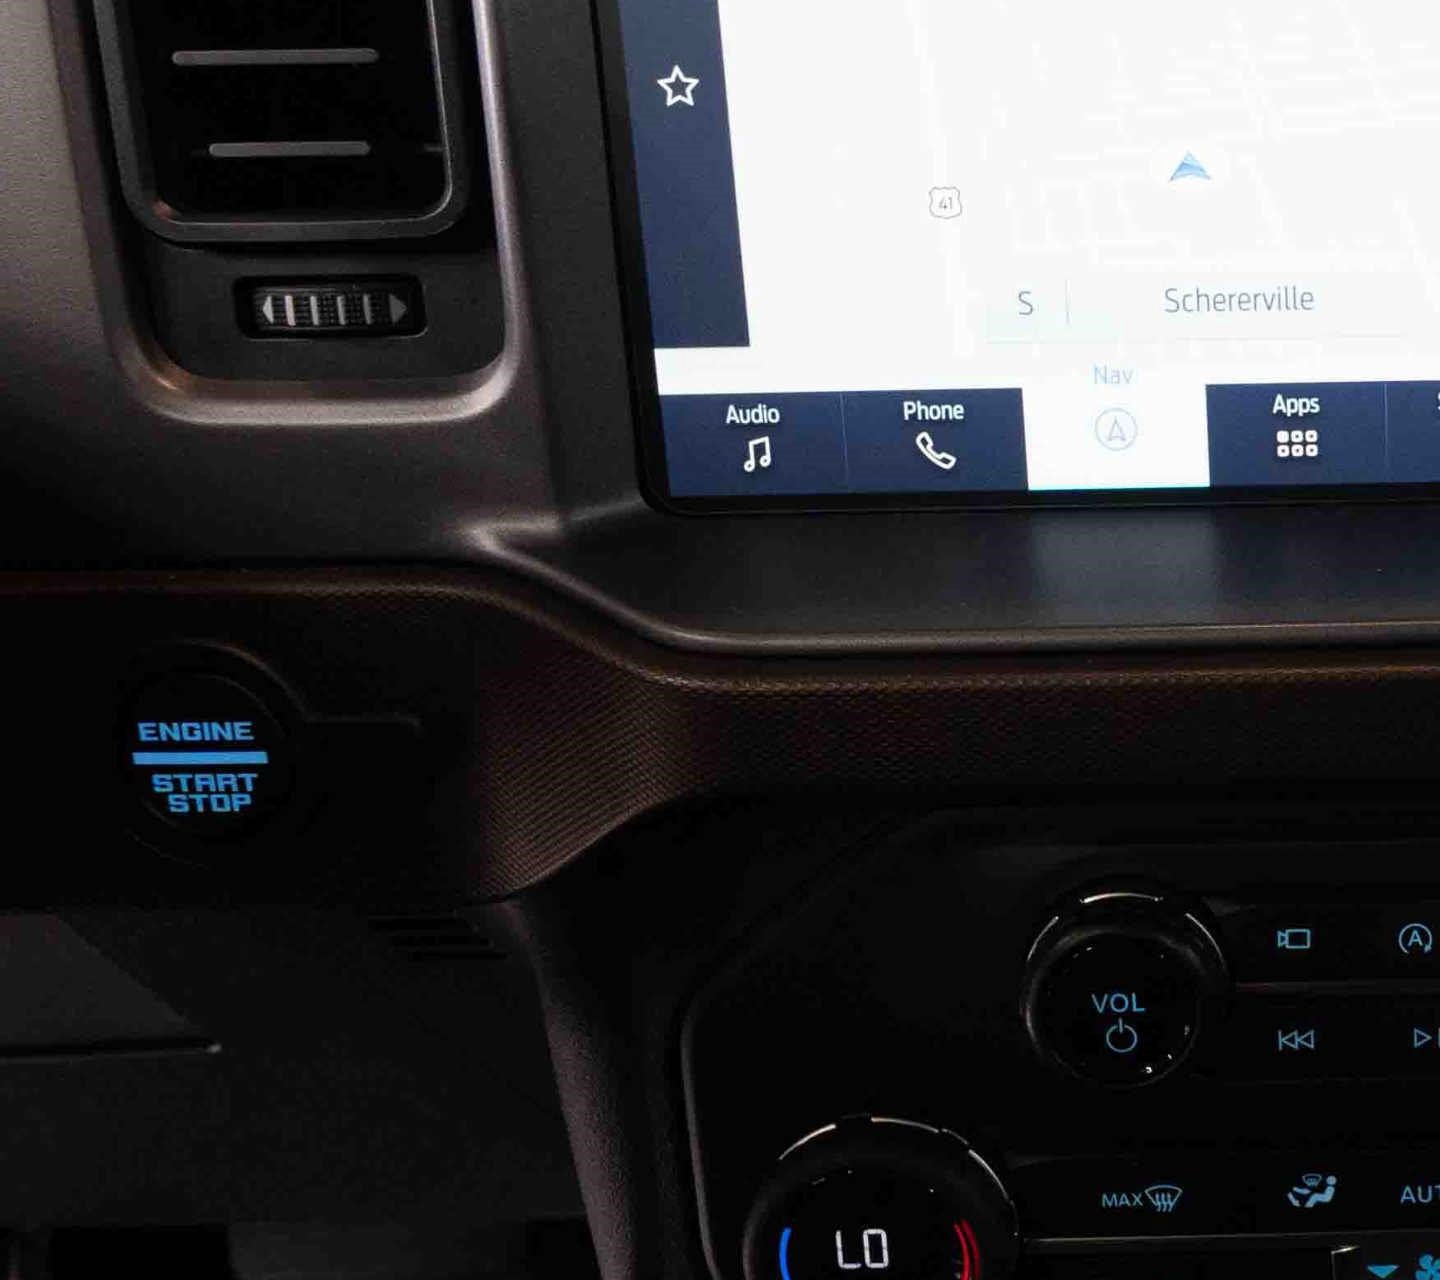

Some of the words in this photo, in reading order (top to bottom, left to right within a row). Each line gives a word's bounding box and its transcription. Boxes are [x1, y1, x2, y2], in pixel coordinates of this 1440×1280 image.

[937, 195, 955, 213] 41
[1017, 289, 1035, 317] S
[1163, 285, 1316, 316] Schererville
[1093, 364, 1135, 385] Nav
[725, 402, 781, 426] Audio
[902, 399, 966, 422] Phone
[1272, 392, 1321, 418] Apps
[137, 721, 255, 743] ENGINE
[150, 772, 259, 793] START
[167, 792, 253, 813] STOP
[1090, 992, 1147, 1015] VOL
[1101, 1192, 1144, 1208] MAX
